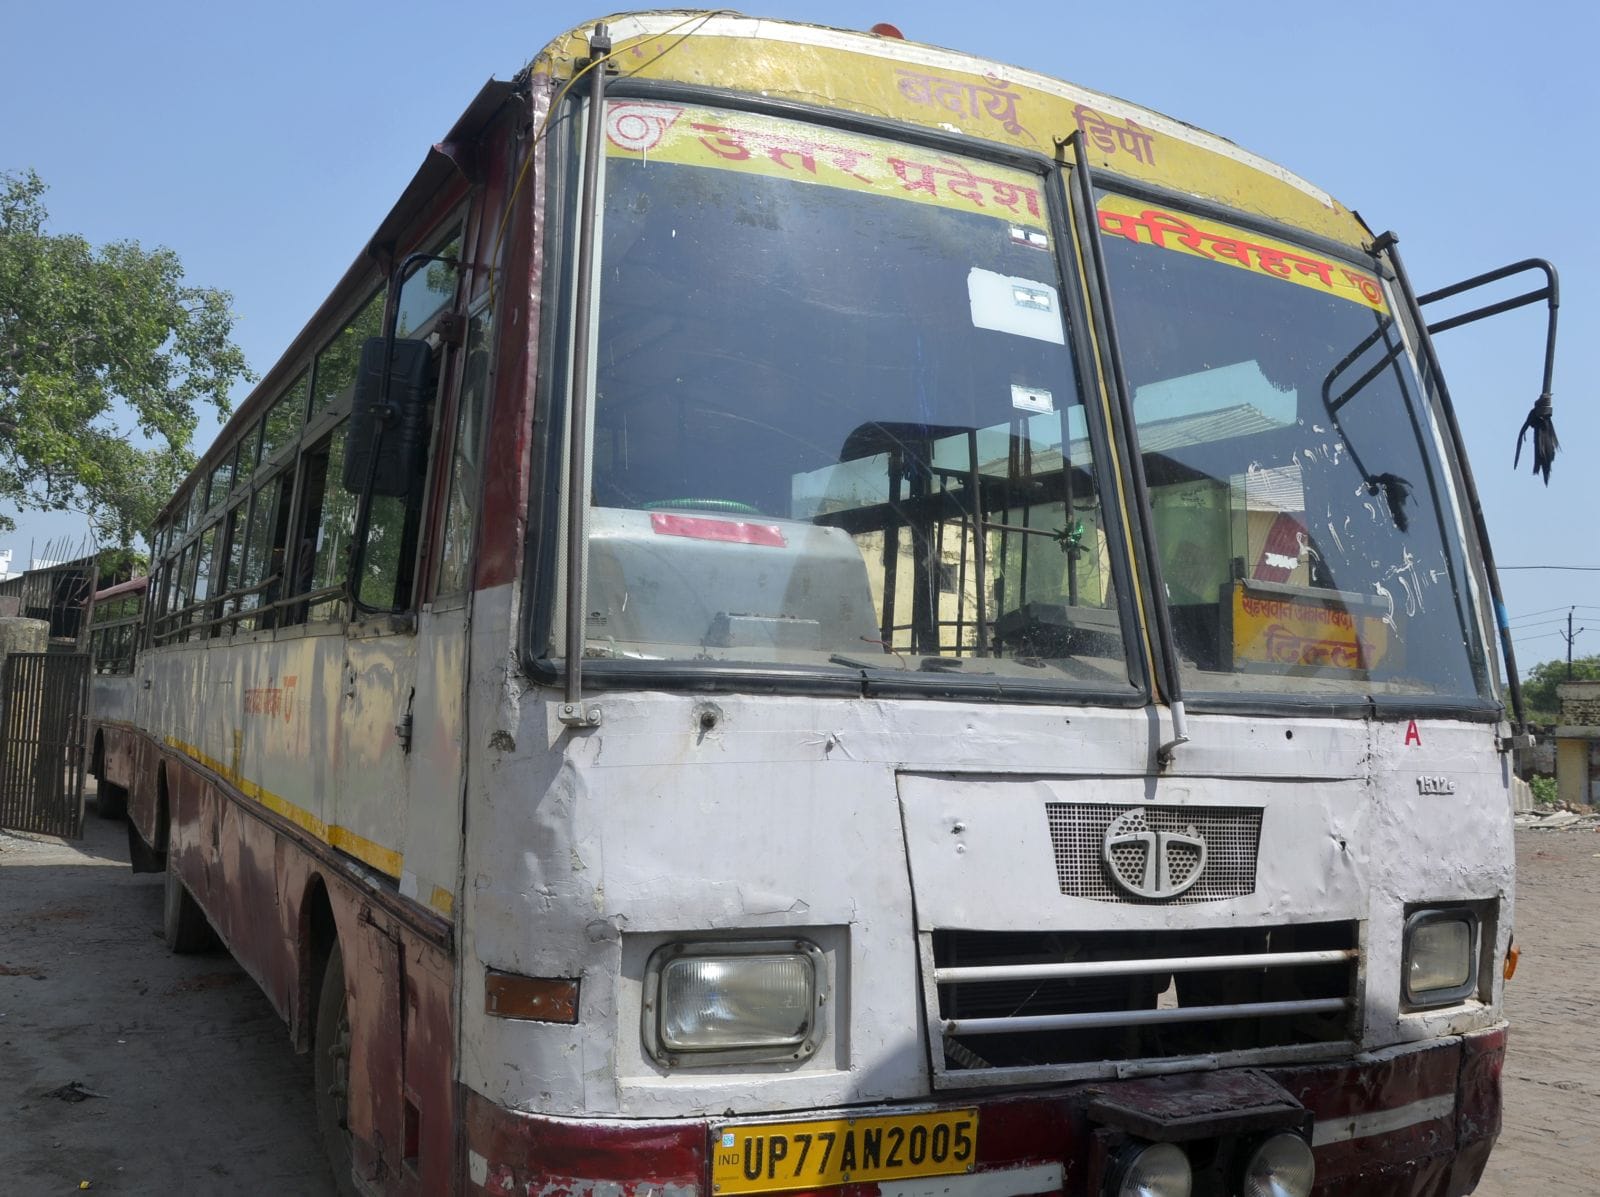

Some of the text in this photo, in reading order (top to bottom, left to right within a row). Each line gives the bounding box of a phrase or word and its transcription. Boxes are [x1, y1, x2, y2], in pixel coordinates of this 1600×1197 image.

[1097, 210, 1334, 288] परिवहन
[1404, 717, 1422, 746] A
[718, 1121, 972, 1181] IND UP77AN2005
